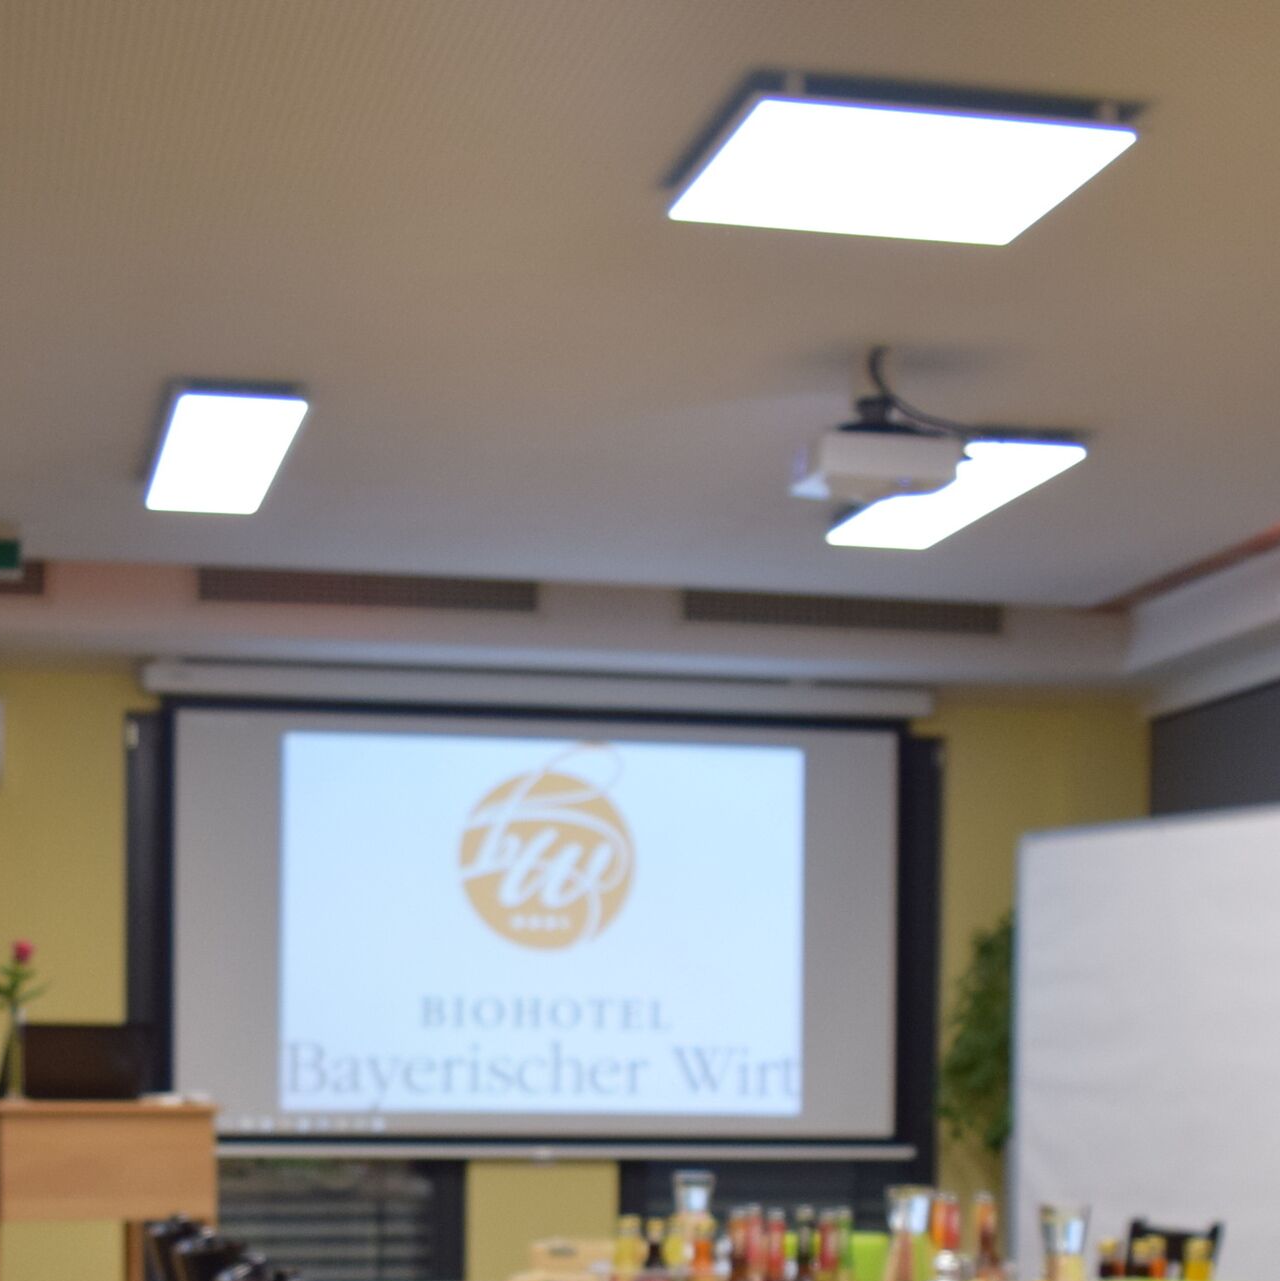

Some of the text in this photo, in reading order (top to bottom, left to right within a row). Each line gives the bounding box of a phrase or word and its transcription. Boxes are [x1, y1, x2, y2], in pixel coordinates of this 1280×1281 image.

[421, 995, 671, 1031] BIOHOTEL
[286, 1040, 803, 1111] Bayerischer Wirt
